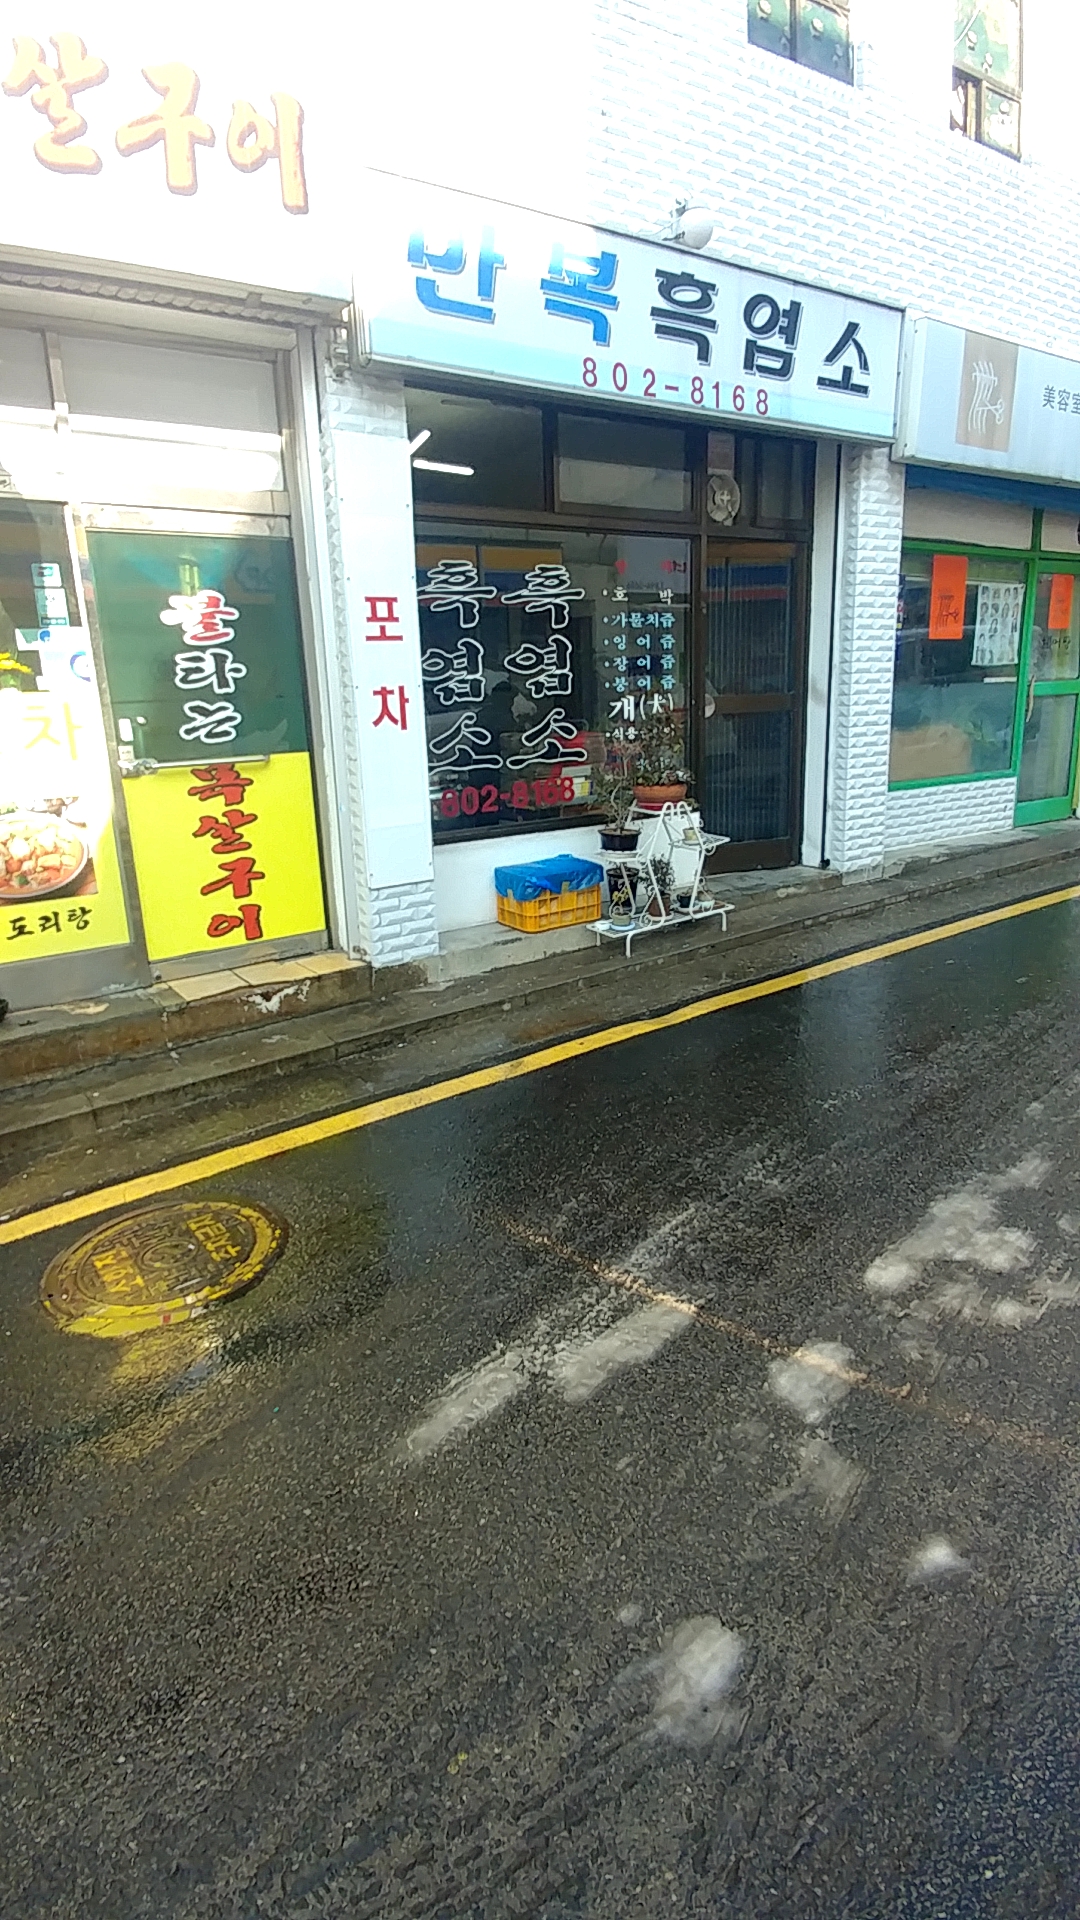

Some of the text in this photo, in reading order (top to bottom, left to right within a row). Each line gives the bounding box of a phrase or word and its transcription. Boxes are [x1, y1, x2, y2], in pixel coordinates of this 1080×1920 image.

[2, 32, 309, 215] 살구이
[582, 356, 770, 416] 802-8168
[364, 596, 410, 731] 포차
[416, 559, 503, 776] 흑염소
[501, 563, 588, 770] 흑염소
[187, 763, 265, 940] 목살구이
[440, 777, 575, 819] 802-8168
[6, 906, 93, 940] 도리탕
